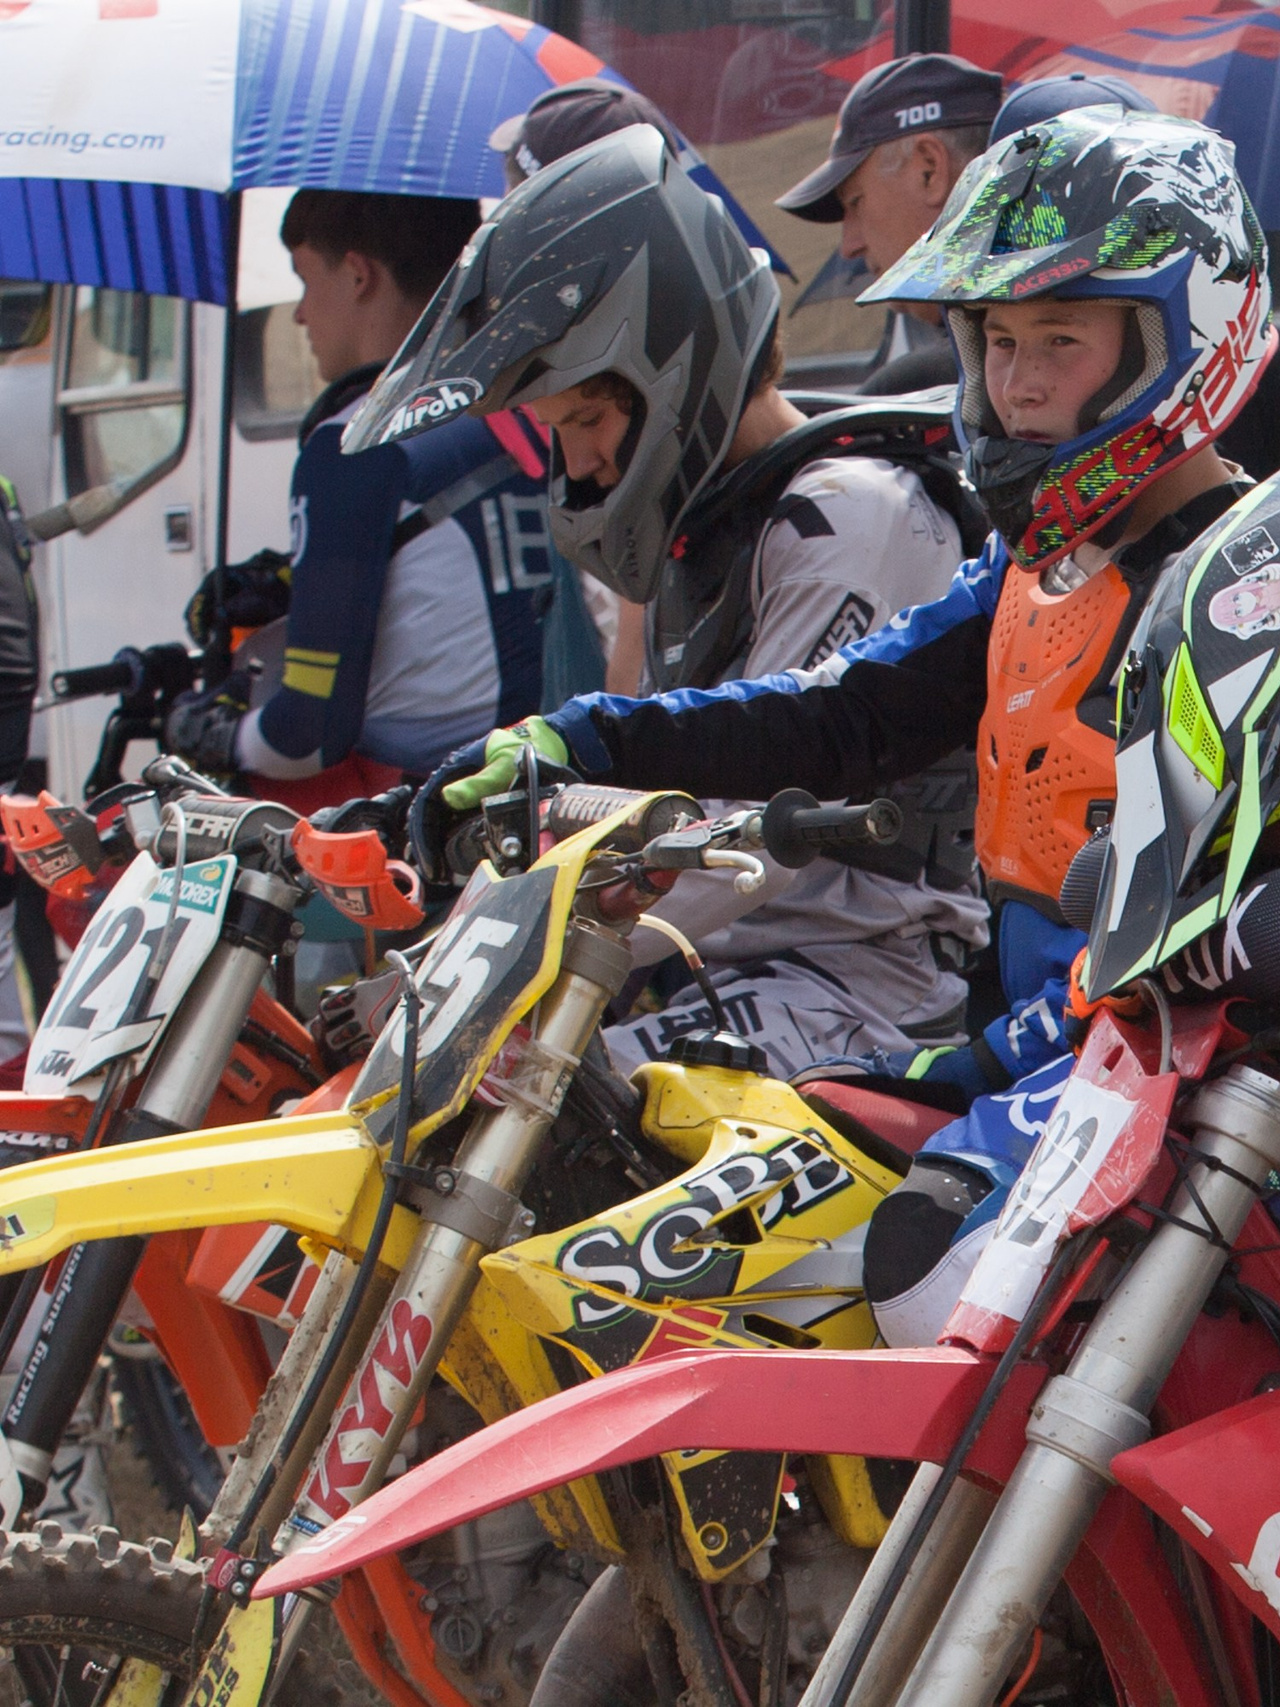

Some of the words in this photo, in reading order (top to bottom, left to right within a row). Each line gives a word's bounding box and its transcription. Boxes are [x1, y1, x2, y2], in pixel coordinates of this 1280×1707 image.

[894, 101, 941, 129] 700
[1013, 257, 1091, 297] ACERBIS
[157, 876, 220, 908] MOOREX
[43, 906, 192, 1031] 121
[35, 1050, 76, 1077] KTM
[6, 1339, 49, 1426] Racing
[41, 1240, 88, 1335] Suspen
[305, 1299, 433, 1518] KYB
